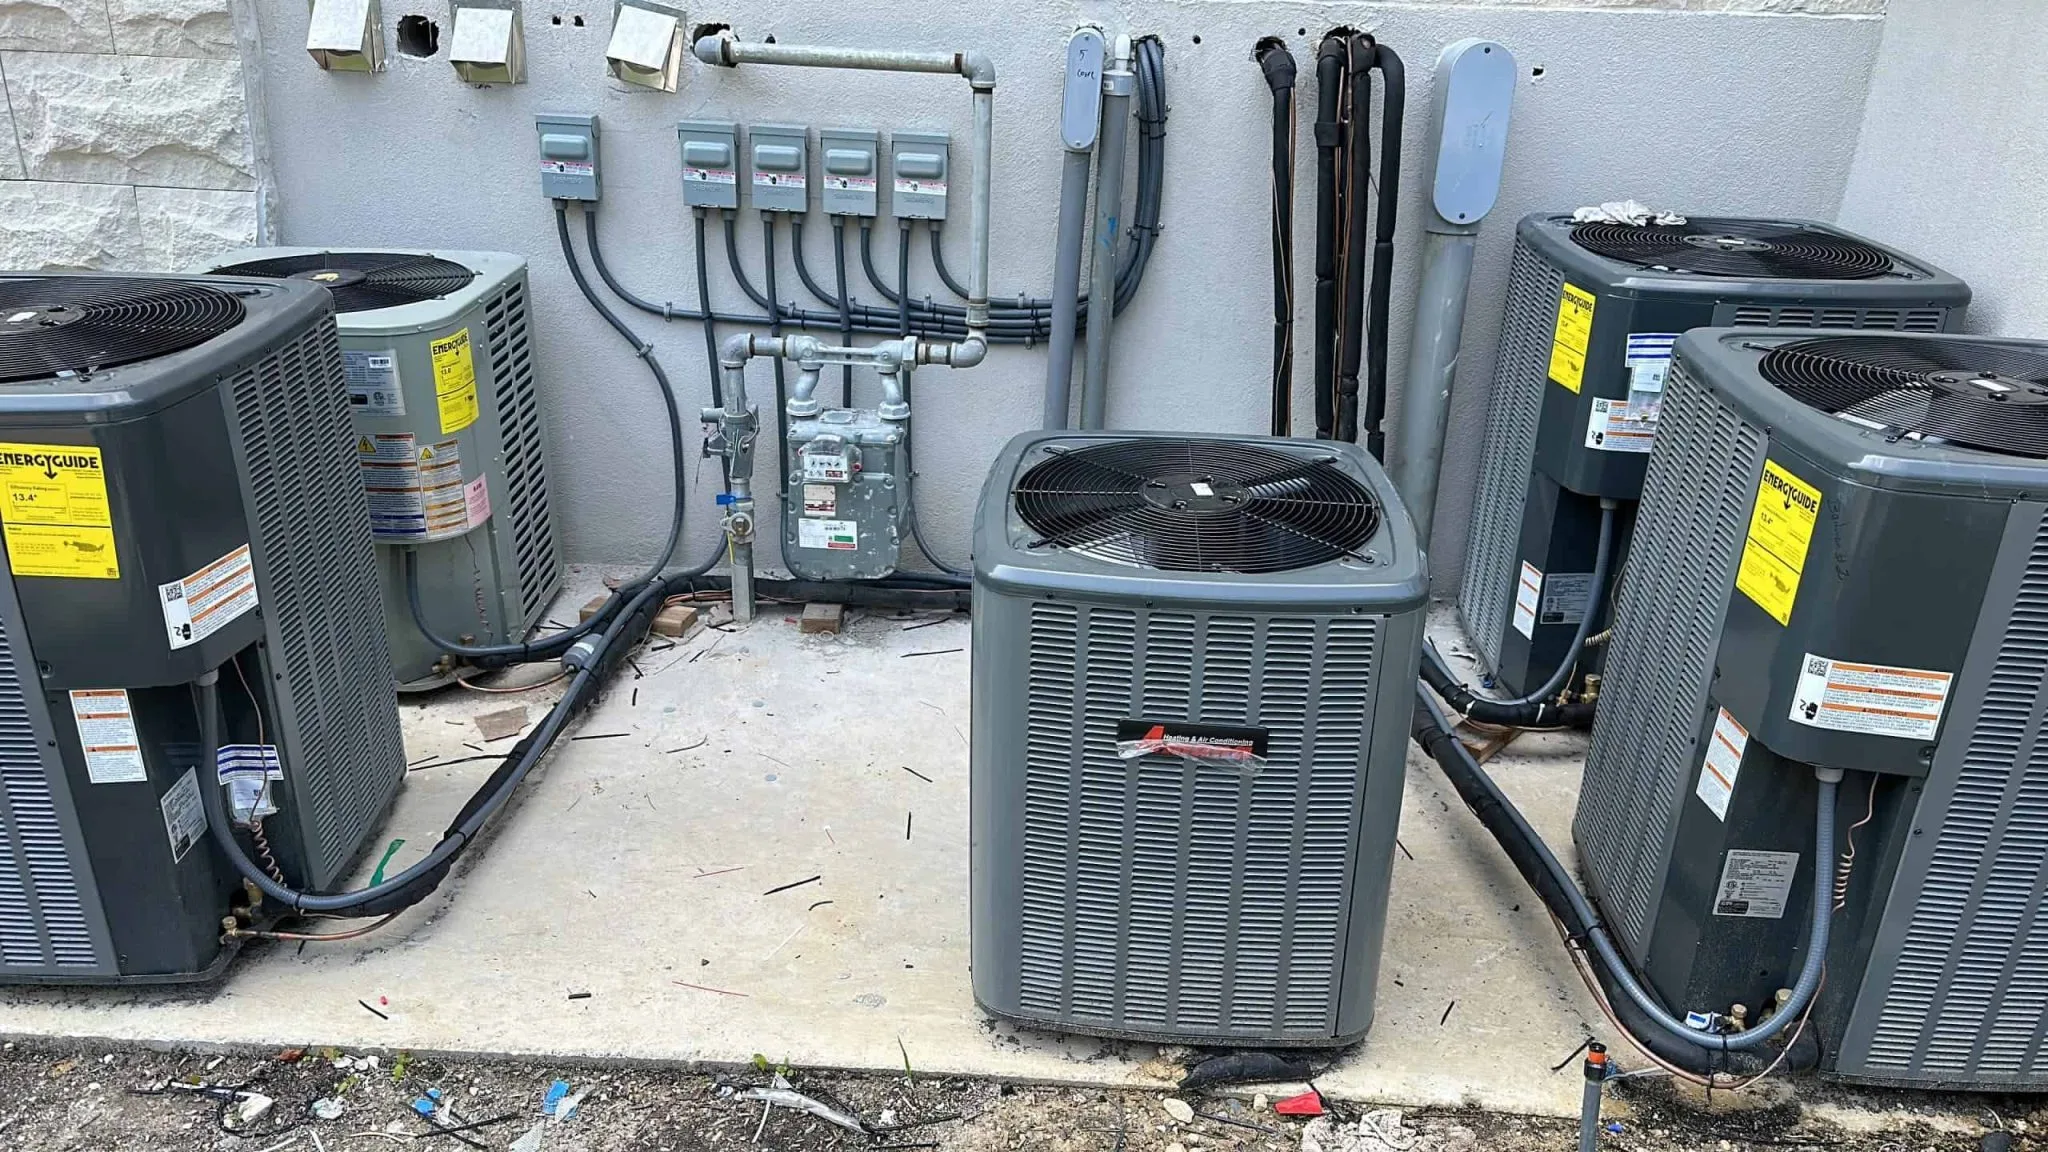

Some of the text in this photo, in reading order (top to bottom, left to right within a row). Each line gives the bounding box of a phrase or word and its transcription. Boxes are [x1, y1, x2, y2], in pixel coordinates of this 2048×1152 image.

[1763, 468, 1818, 513] ENERGYGUIDE
[1163, 734, 1190, 743] Heating
[1190, 735, 1197, 743] &
[1209, 737, 1254, 747] Conditioning
